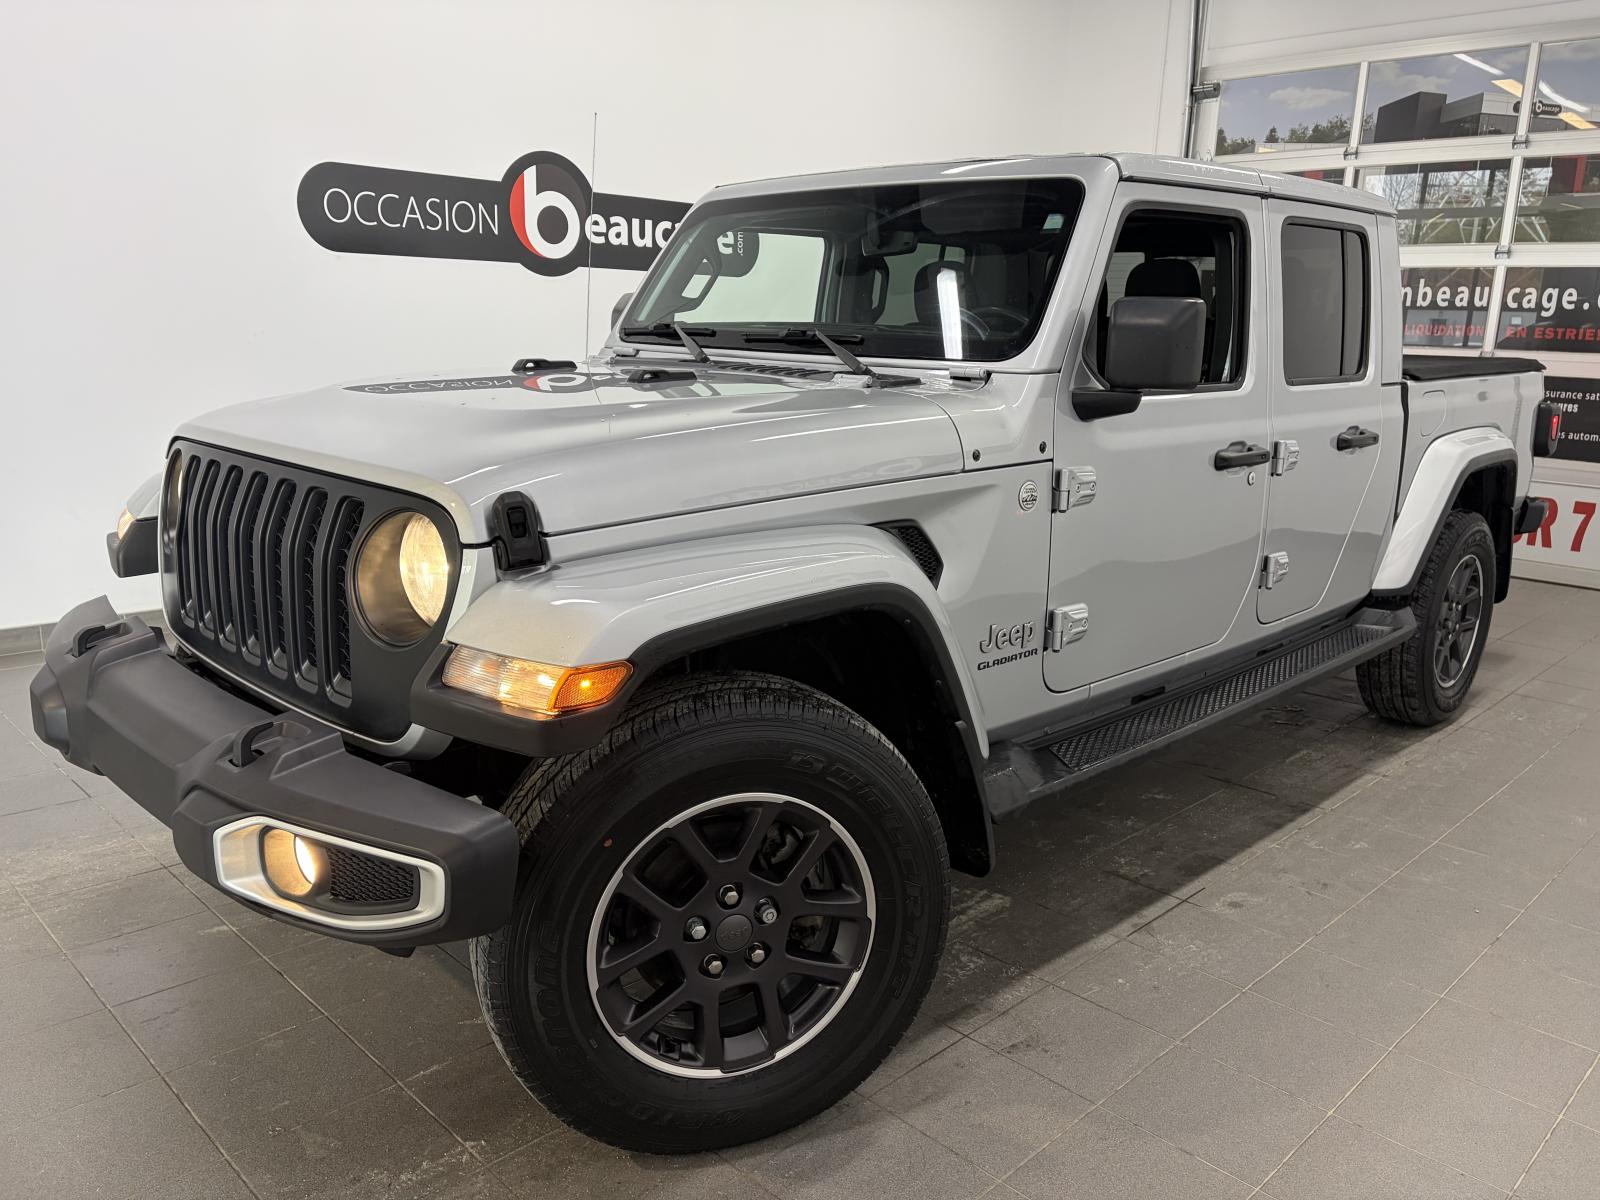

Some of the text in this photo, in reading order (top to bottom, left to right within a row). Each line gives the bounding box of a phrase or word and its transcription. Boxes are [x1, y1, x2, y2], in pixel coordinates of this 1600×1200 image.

[323, 187, 500, 235] OCCASION
[1404, 323, 1484, 337] LIQUIDATION
[1506, 325, 1528, 338] EN
[1544, 390, 1583, 400] surance
[1570, 501, 1597, 553] 7
[979, 621, 1034, 654] Jeep
[977, 647, 1039, 671] GLADIATOR
